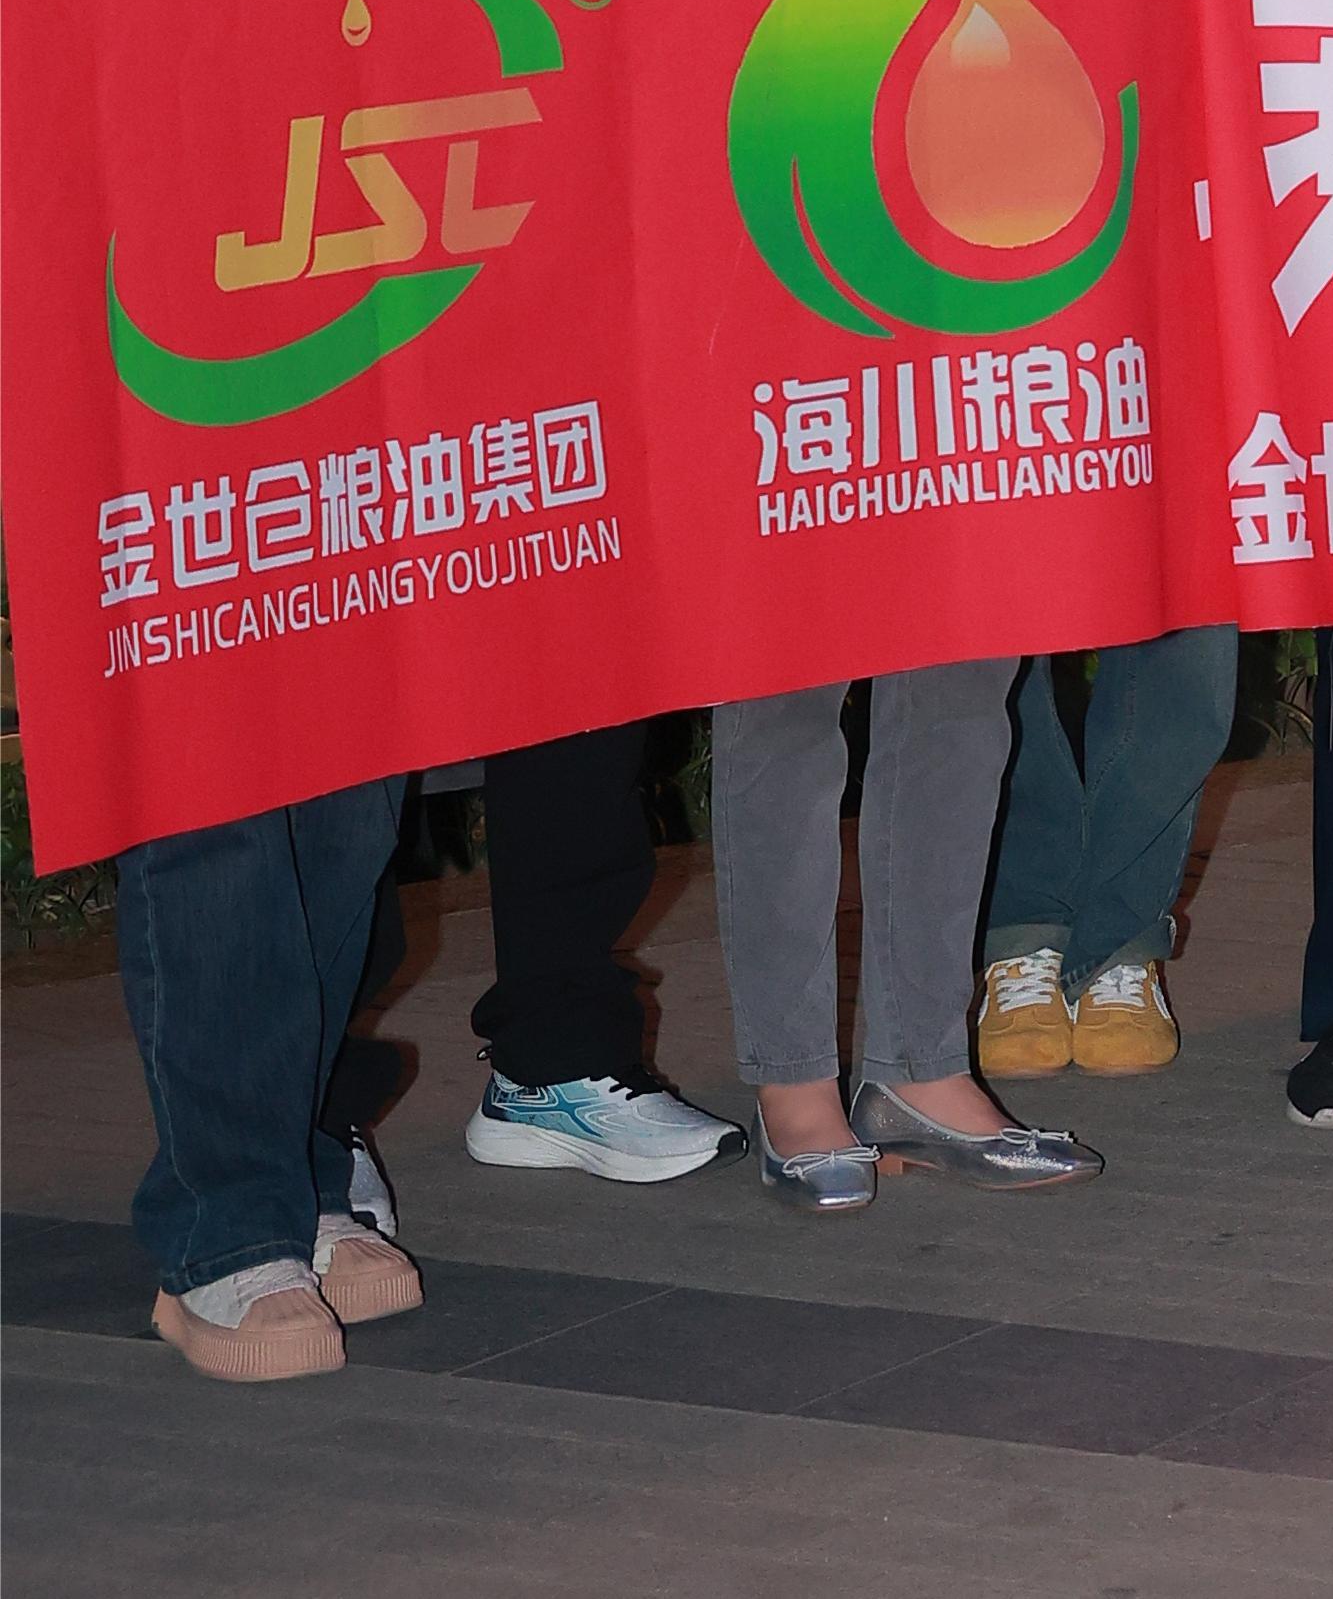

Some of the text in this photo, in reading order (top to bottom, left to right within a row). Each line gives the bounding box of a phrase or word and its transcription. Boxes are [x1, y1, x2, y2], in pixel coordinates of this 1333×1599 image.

[754, 336, 1150, 486] 海川粮油
[98, 400, 607, 608] 金世仓粮油集团
[758, 442, 1154, 537] HAICHUANLIANGYOU
[104, 516, 622, 678] JINSHICANGLIANGYOUJITUAN
